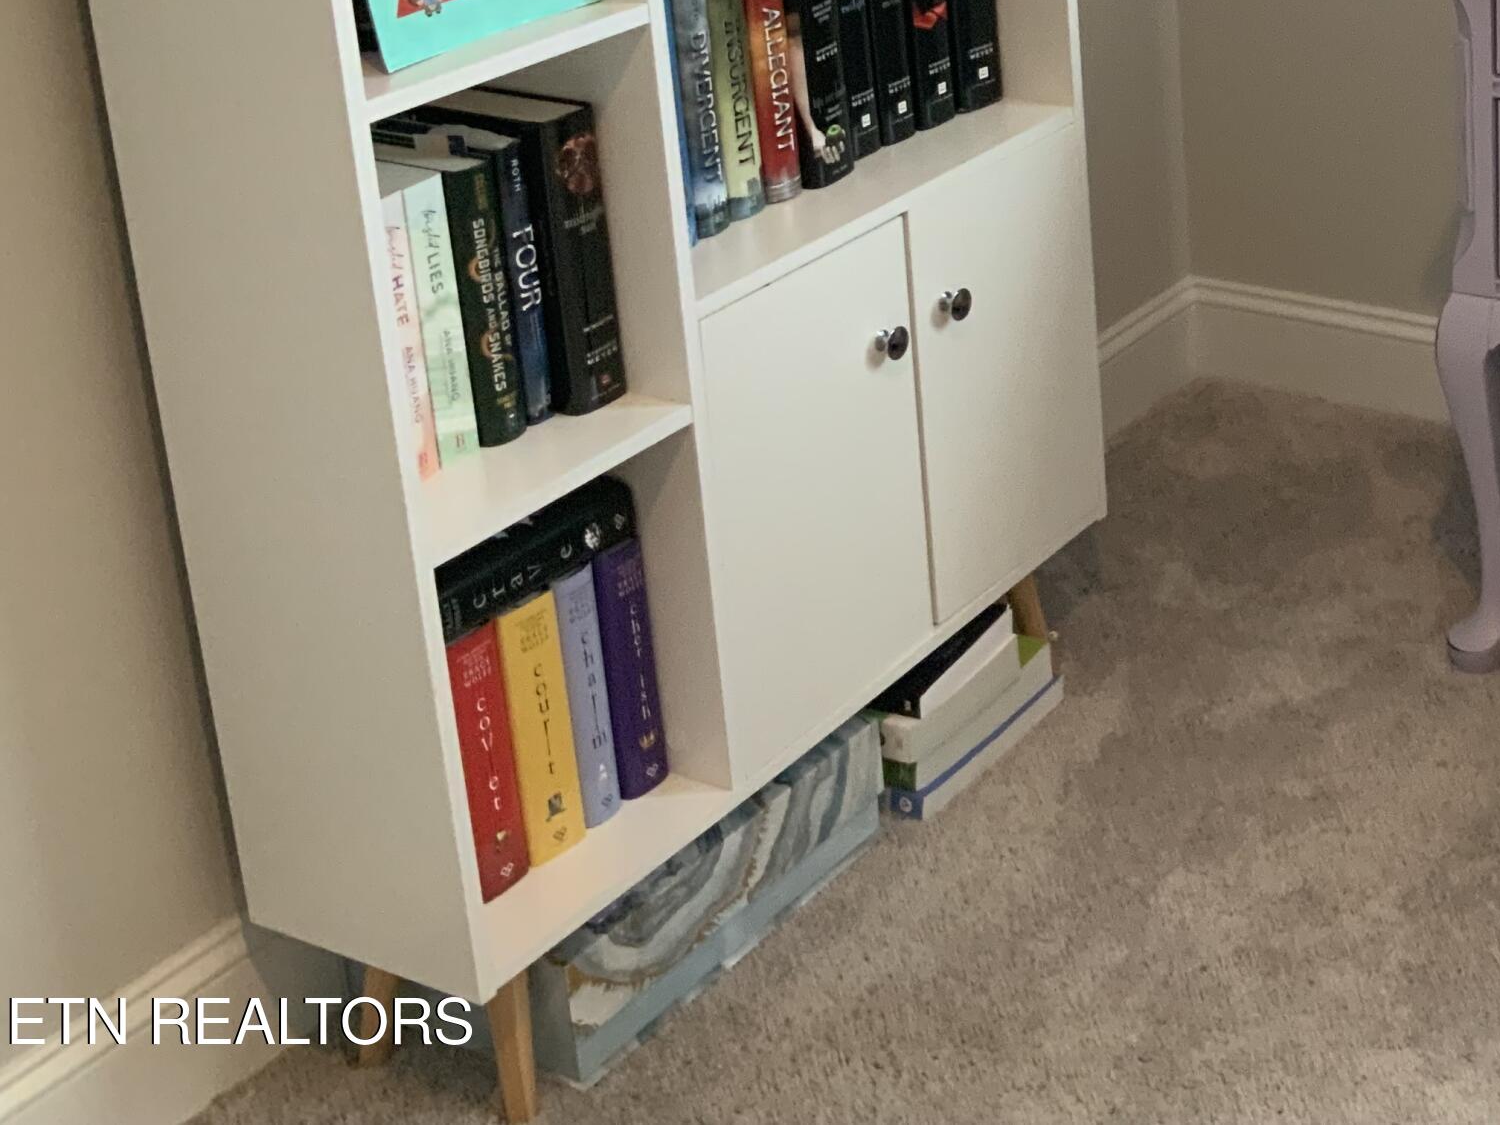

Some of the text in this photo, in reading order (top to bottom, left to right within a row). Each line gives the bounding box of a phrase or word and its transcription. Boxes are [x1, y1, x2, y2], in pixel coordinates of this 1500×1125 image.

[762, 6, 796, 151] ALLEGIANT
[928, 61, 951, 76] MEYER
[969, 46, 994, 60] MEYER
[689, 30, 725, 183] DIVERGENT
[723, 19, 757, 166] INSURGENT
[510, 158, 521, 192] ROTH
[427, 251, 444, 295] LIES
[472, 218, 495, 304] SONGBIRDS
[512, 222, 543, 312] FOUR
[391, 274, 410, 326] HATE
[486, 307, 498, 330] AND
[494, 270, 511, 331] BALLAD
[488, 331, 508, 392] SNAKES
[580, 630, 608, 750] charm
[476, 697, 502, 811] covet
